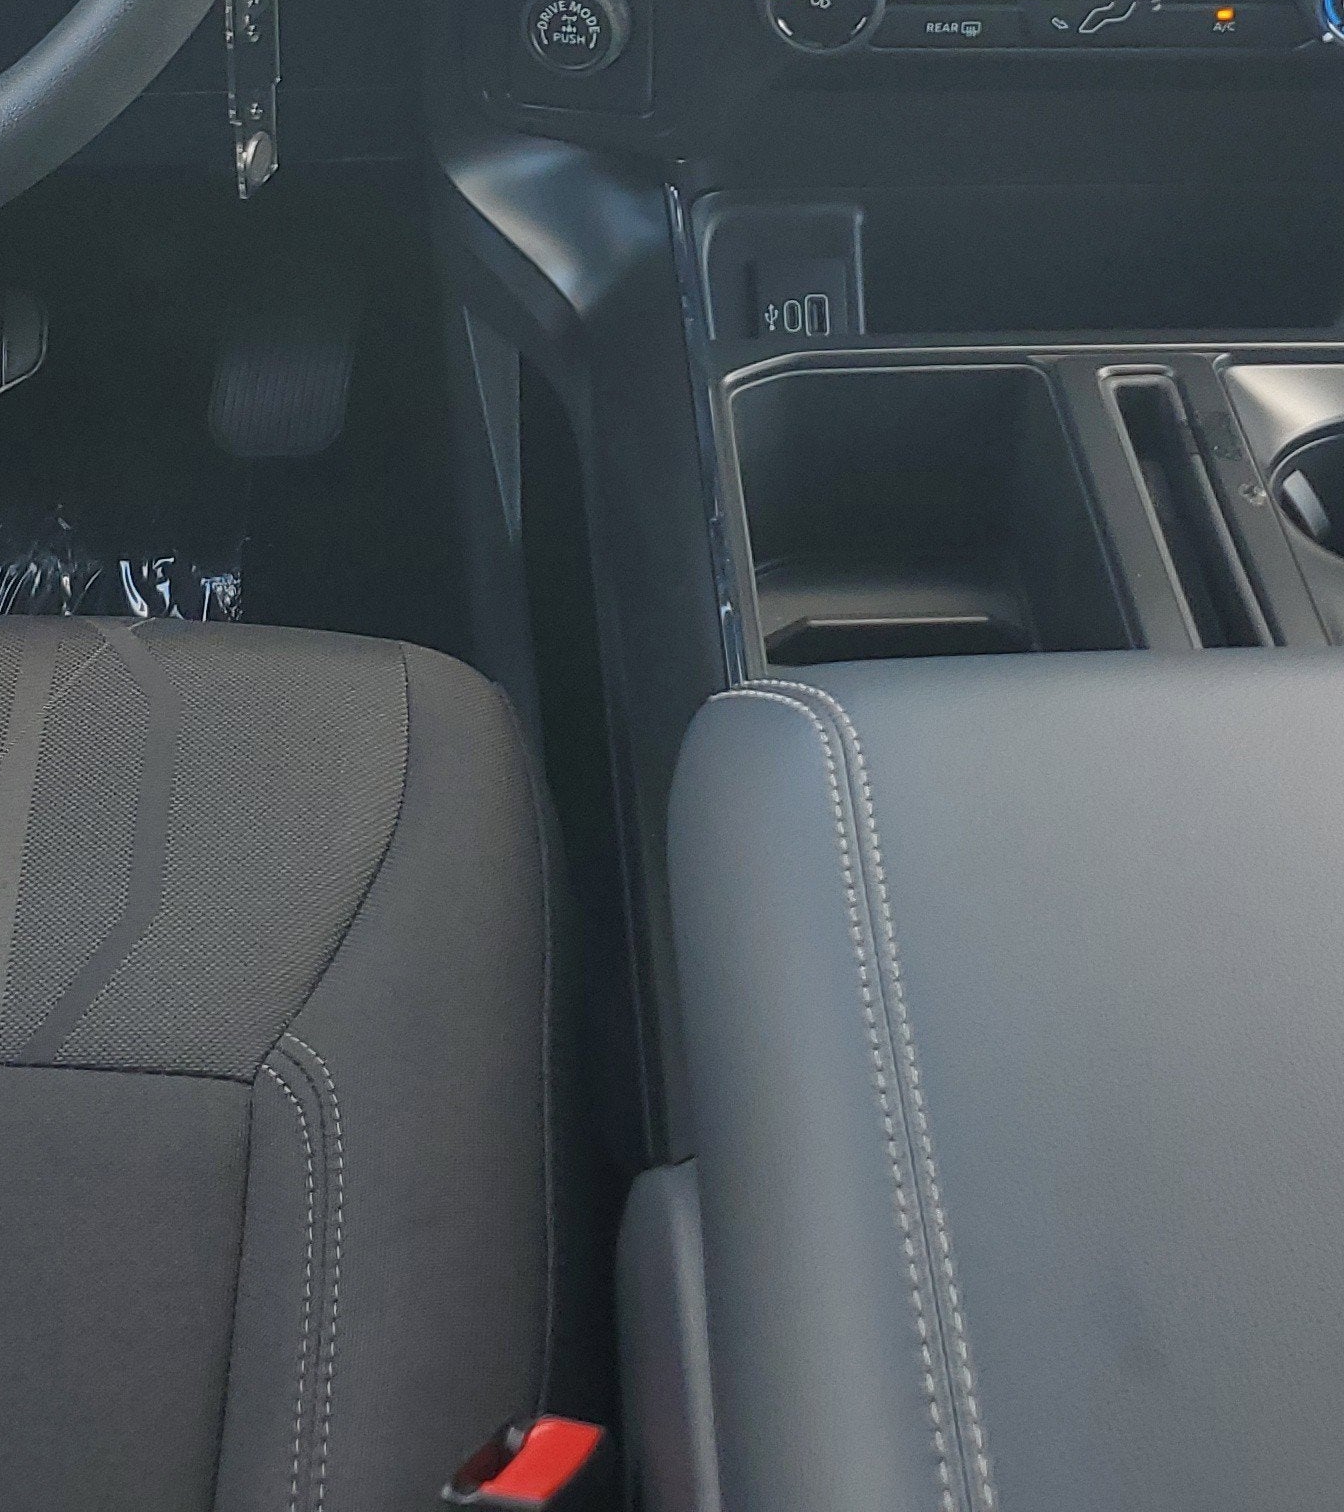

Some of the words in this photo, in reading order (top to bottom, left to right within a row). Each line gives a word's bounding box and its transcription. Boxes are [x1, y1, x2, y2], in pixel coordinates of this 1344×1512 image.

[537, 0, 567, 30] DRIVE
[569, 0, 601, 35] MODE
[926, 22, 958, 33] REAR
[1213, 21, 1236, 33] A/C
[553, 32, 586, 45] PUSH
